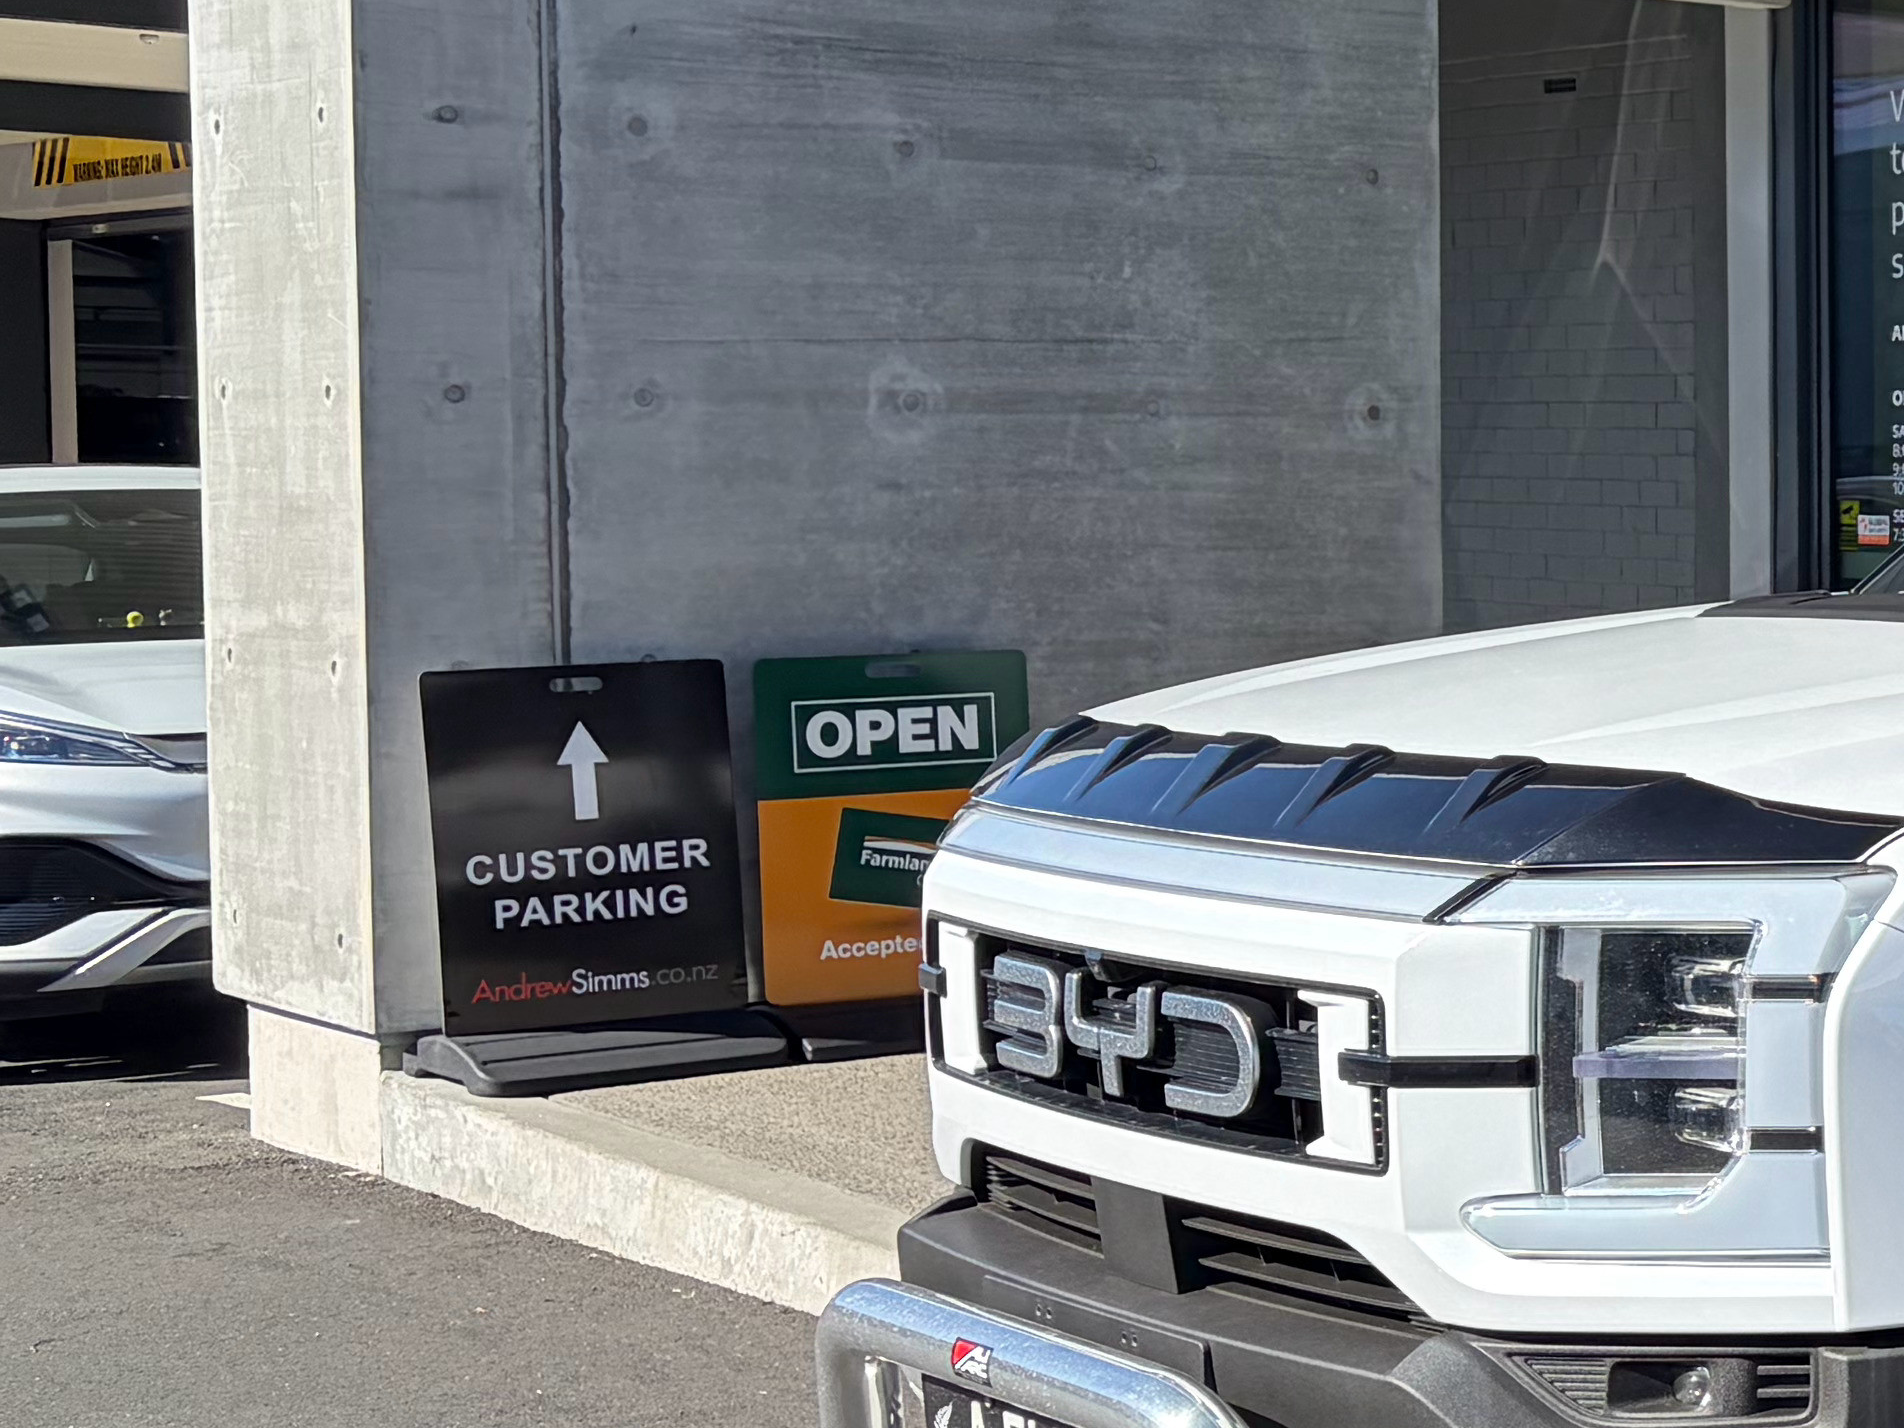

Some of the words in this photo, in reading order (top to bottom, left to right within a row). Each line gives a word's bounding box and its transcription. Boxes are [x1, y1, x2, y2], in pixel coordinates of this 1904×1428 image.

[805, 703, 980, 760] OPEN
[465, 837, 712, 886] CUSTOMER
[860, 849, 931, 872] Farmlan
[494, 883, 689, 930] PARKING
[819, 934, 924, 961] Accepte
[471, 963, 719, 1005] AndrewSimms.co.nz
[990, 948, 1263, 1120] BYD
